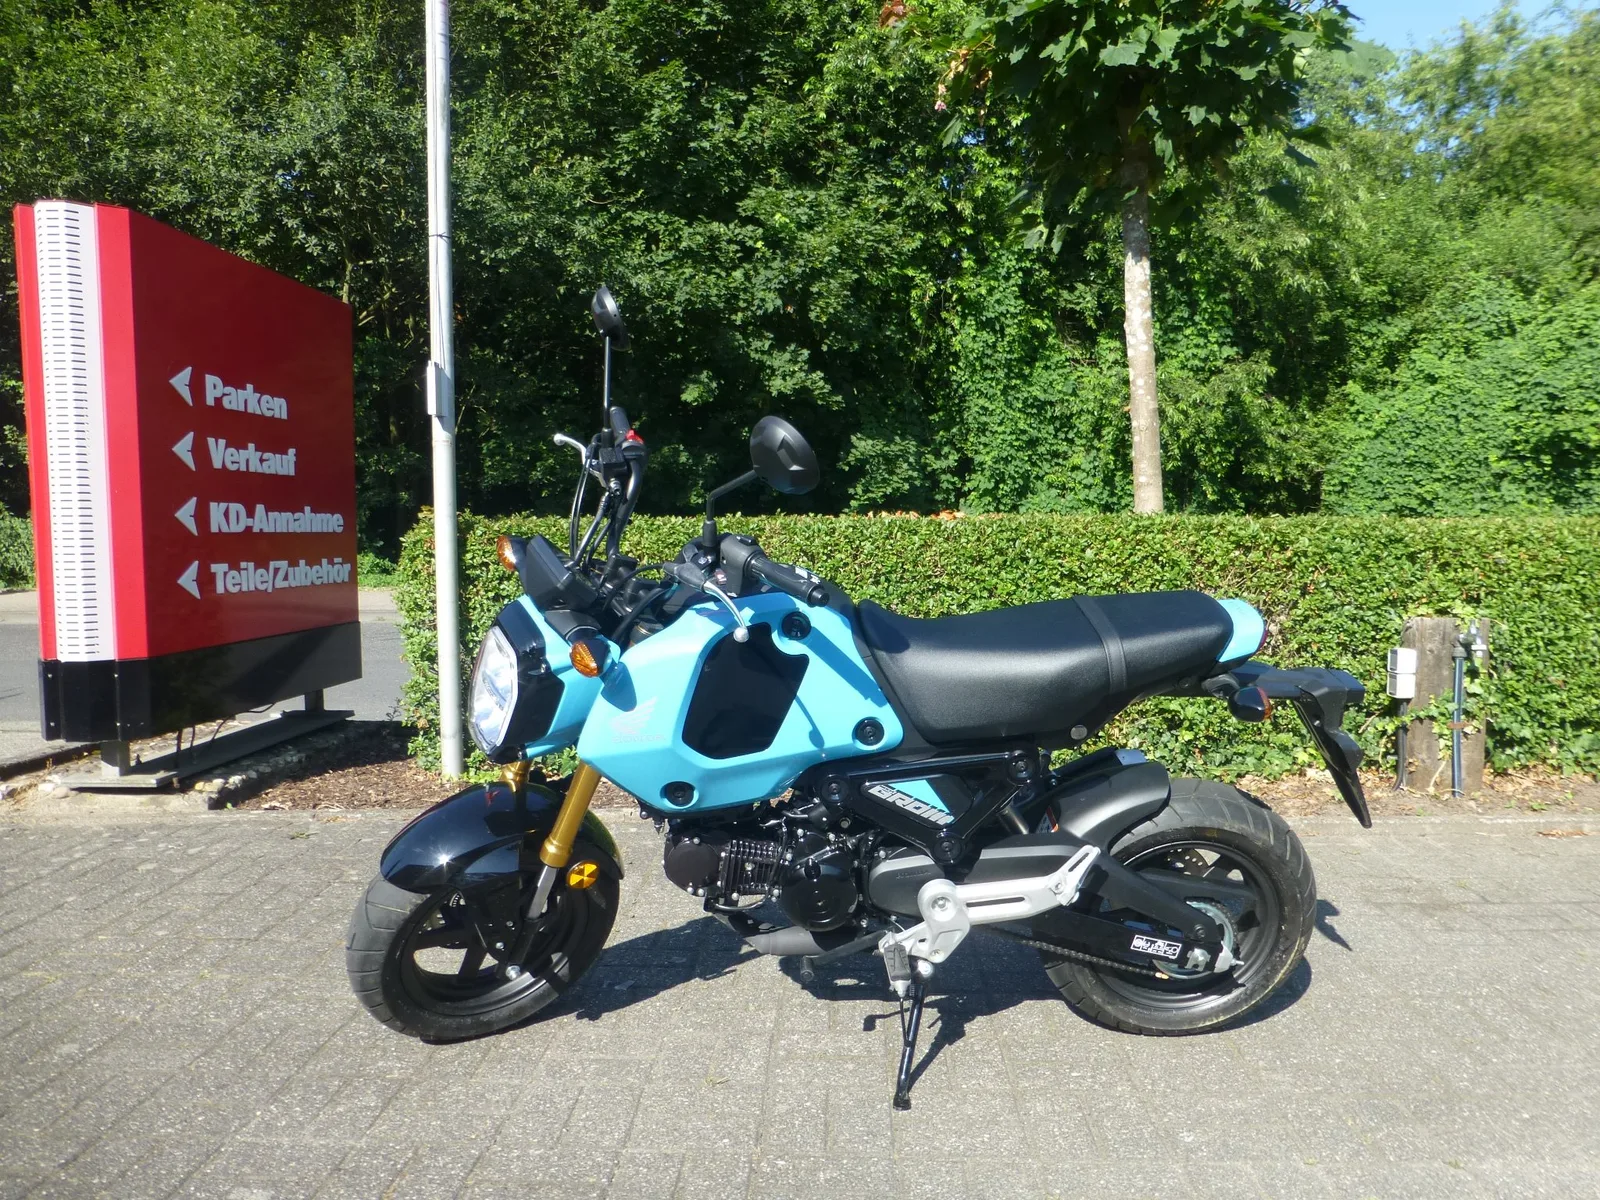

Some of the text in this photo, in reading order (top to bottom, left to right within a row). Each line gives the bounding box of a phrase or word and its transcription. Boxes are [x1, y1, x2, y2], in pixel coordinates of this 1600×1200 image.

[205, 374, 288, 420] Parken
[207, 437, 296, 476] Verkauf
[209, 502, 344, 533] KD-Annahme
[210, 558, 351, 594] Teile/Zubehör
